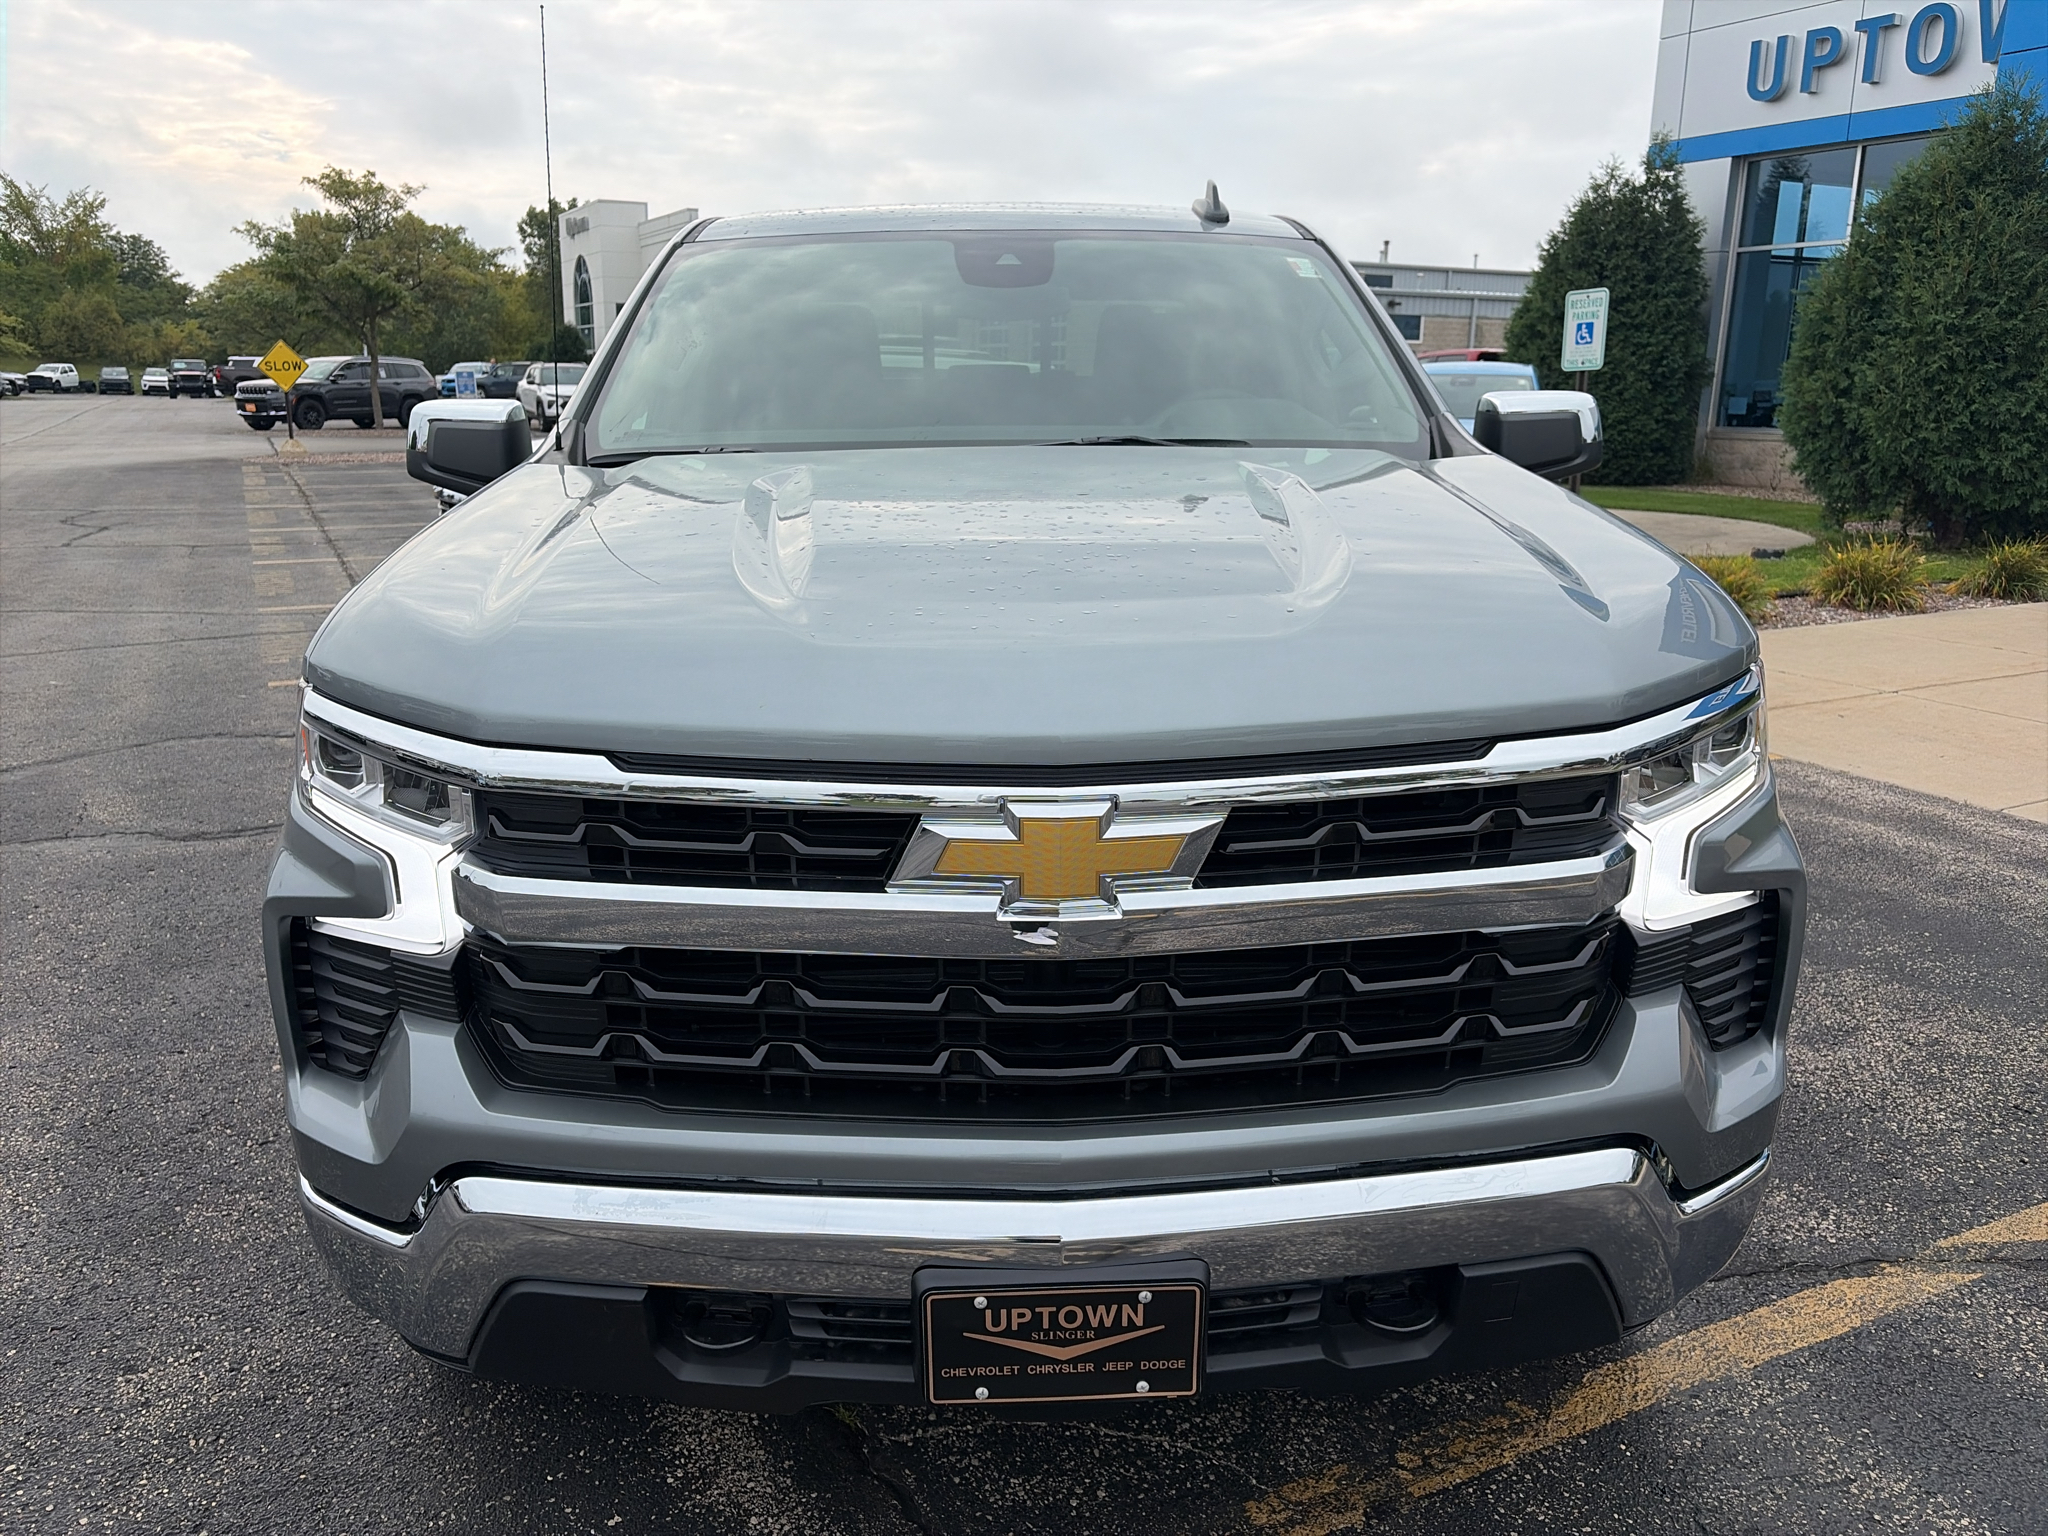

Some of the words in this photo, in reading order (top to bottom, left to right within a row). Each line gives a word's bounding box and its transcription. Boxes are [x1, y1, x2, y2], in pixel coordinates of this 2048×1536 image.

[1570, 297, 1604, 309] RESERVED
[1572, 309, 1600, 321] PARKING
[264, 360, 302, 372] SLOW
[985, 1303, 1144, 1332] UPTOWN
[1031, 1329, 1096, 1341] SLINGER
[941, 1365, 1020, 1378] CHEVROLET
[1027, 1363, 1095, 1375] CHRYSLER
[1102, 1361, 1134, 1372] JEEP
[1140, 1359, 1186, 1370] DODGE
